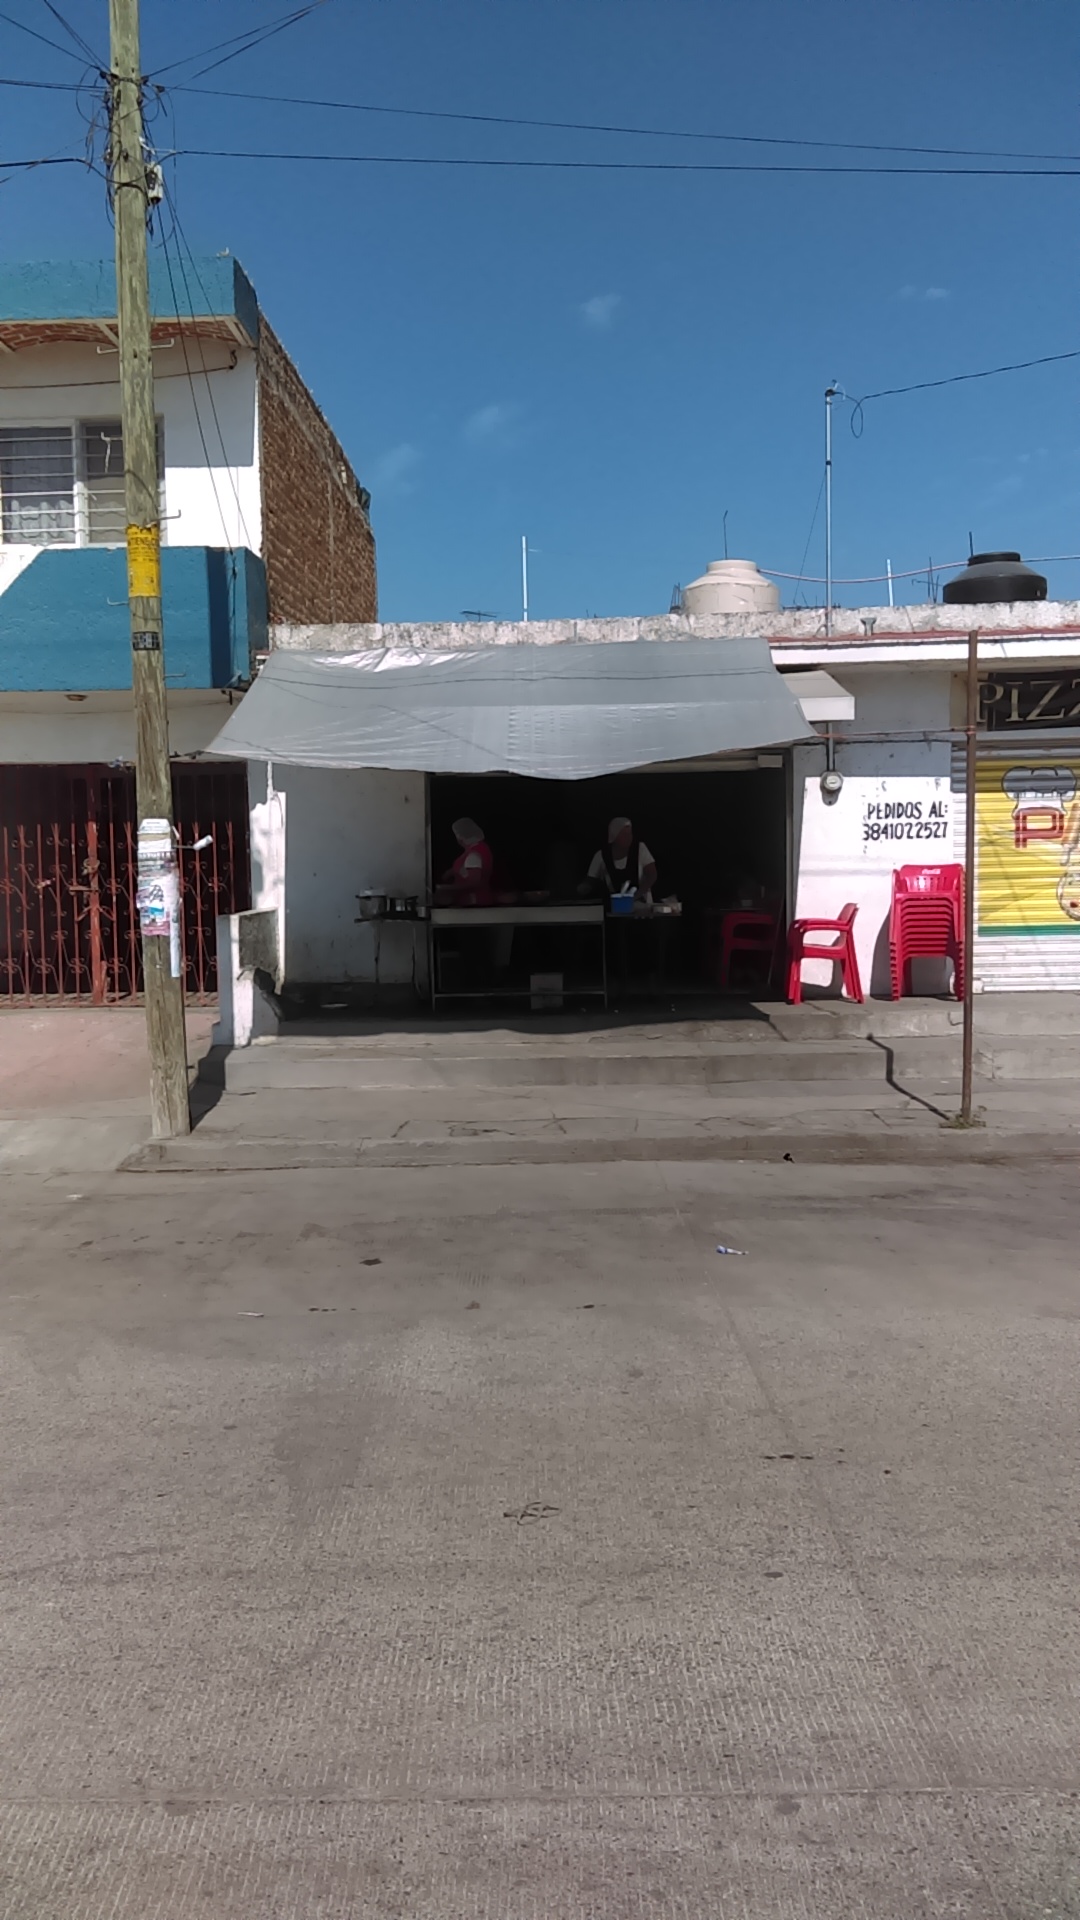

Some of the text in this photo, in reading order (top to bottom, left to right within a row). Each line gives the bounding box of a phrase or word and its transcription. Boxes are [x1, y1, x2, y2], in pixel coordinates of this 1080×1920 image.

[867, 800, 949, 820] PEDIDOS AL:
[862, 821, 948, 841] 3841022527
